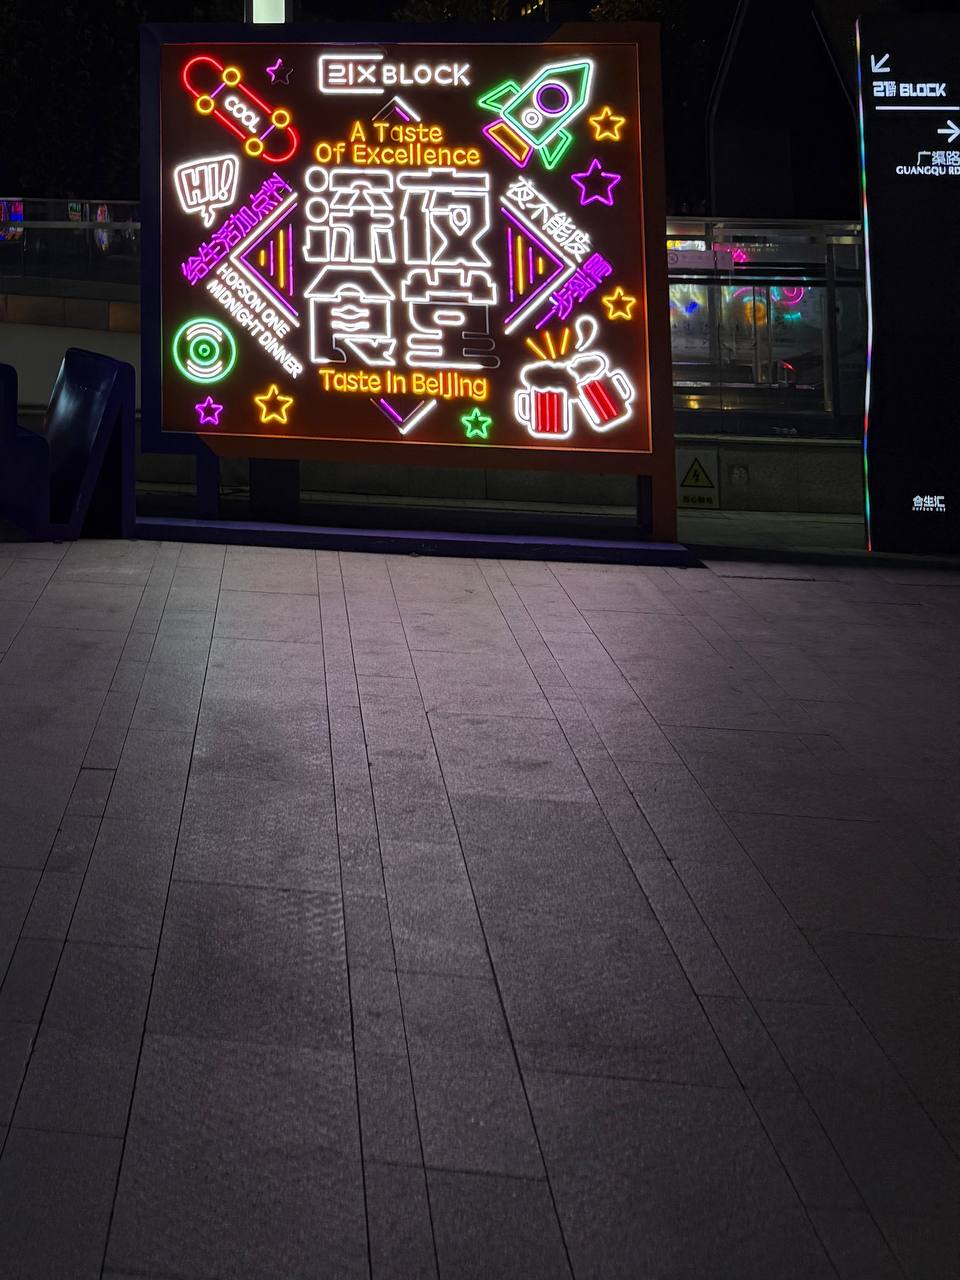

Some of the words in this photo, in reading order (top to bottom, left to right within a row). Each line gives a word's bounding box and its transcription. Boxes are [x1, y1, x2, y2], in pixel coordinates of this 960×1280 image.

[382, 63, 471, 87] BLOCK
[899, 82, 947, 97] BLOCK
[224, 96, 261, 133] COOL
[350, 120, 366, 143] A
[373, 122, 444, 143] Taste
[315, 142, 346, 165] Of
[352, 142, 481, 166] Excellence
[916, 150, 960, 166] 广渠路
[181, 159, 233, 206] HI!
[896, 165, 946, 176] GUANGQU
[181, 172, 293, 286] 给生活加点料
[216, 263, 267, 313] HOPSON
[261, 304, 290, 338] ONE
[206, 280, 265, 337] MIDNIGHT
[258, 328, 304, 379] DINNER
[319, 369, 382, 391] Taste
